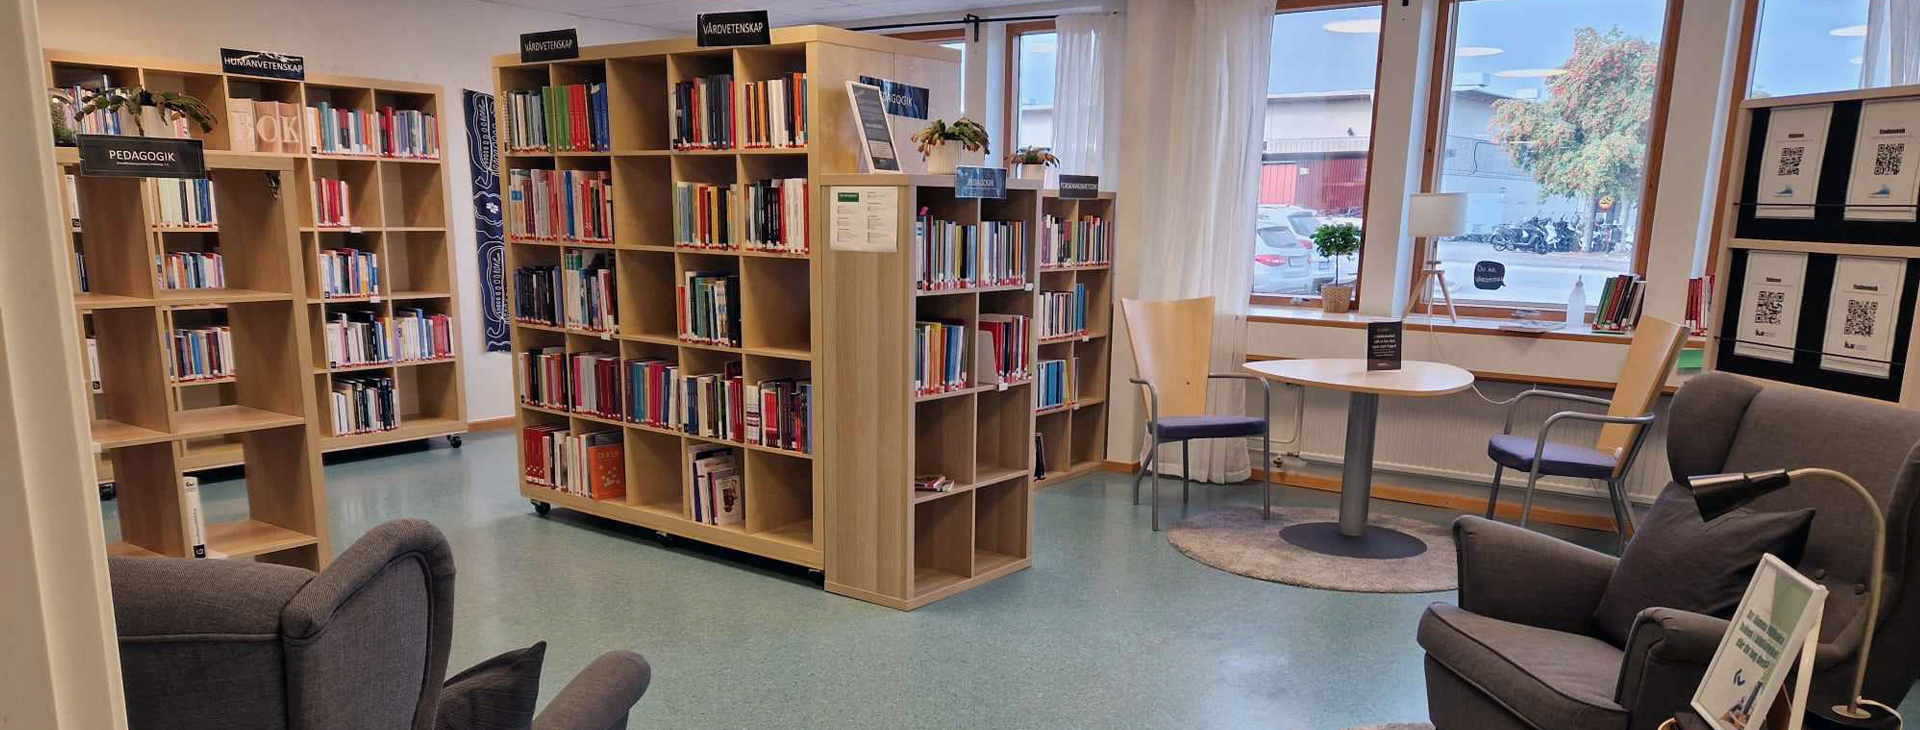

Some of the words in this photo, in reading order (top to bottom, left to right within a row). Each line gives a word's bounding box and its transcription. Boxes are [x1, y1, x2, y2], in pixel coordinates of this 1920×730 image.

[703, 21, 764, 35] VÅRDVETENSKAP
[524, 39, 573, 53] VÅRDVETENSKAP
[223, 56, 304, 72] HUMANVETENSKAP
[109, 150, 176, 162] PEDAGOGIK
